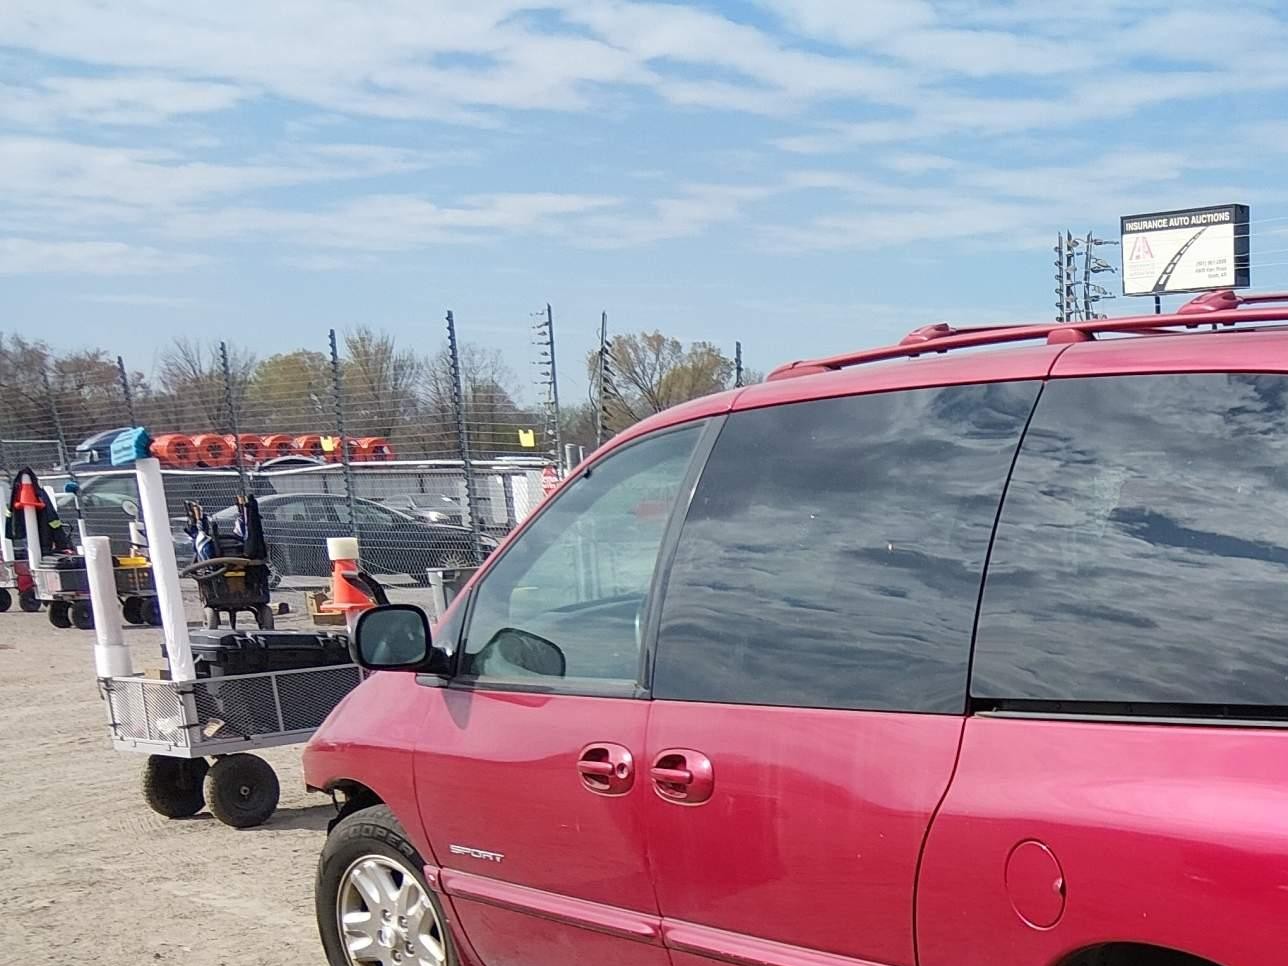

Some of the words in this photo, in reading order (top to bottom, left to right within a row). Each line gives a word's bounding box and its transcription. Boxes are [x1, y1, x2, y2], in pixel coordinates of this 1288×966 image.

[1125, 219, 1168, 231] INSURANCE
[1169, 217, 1189, 227] AUTO
[1191, 212, 1230, 225] AUCTIONS
[341, 824, 415, 856] COOPER
[449, 844, 505, 863] SPORT
